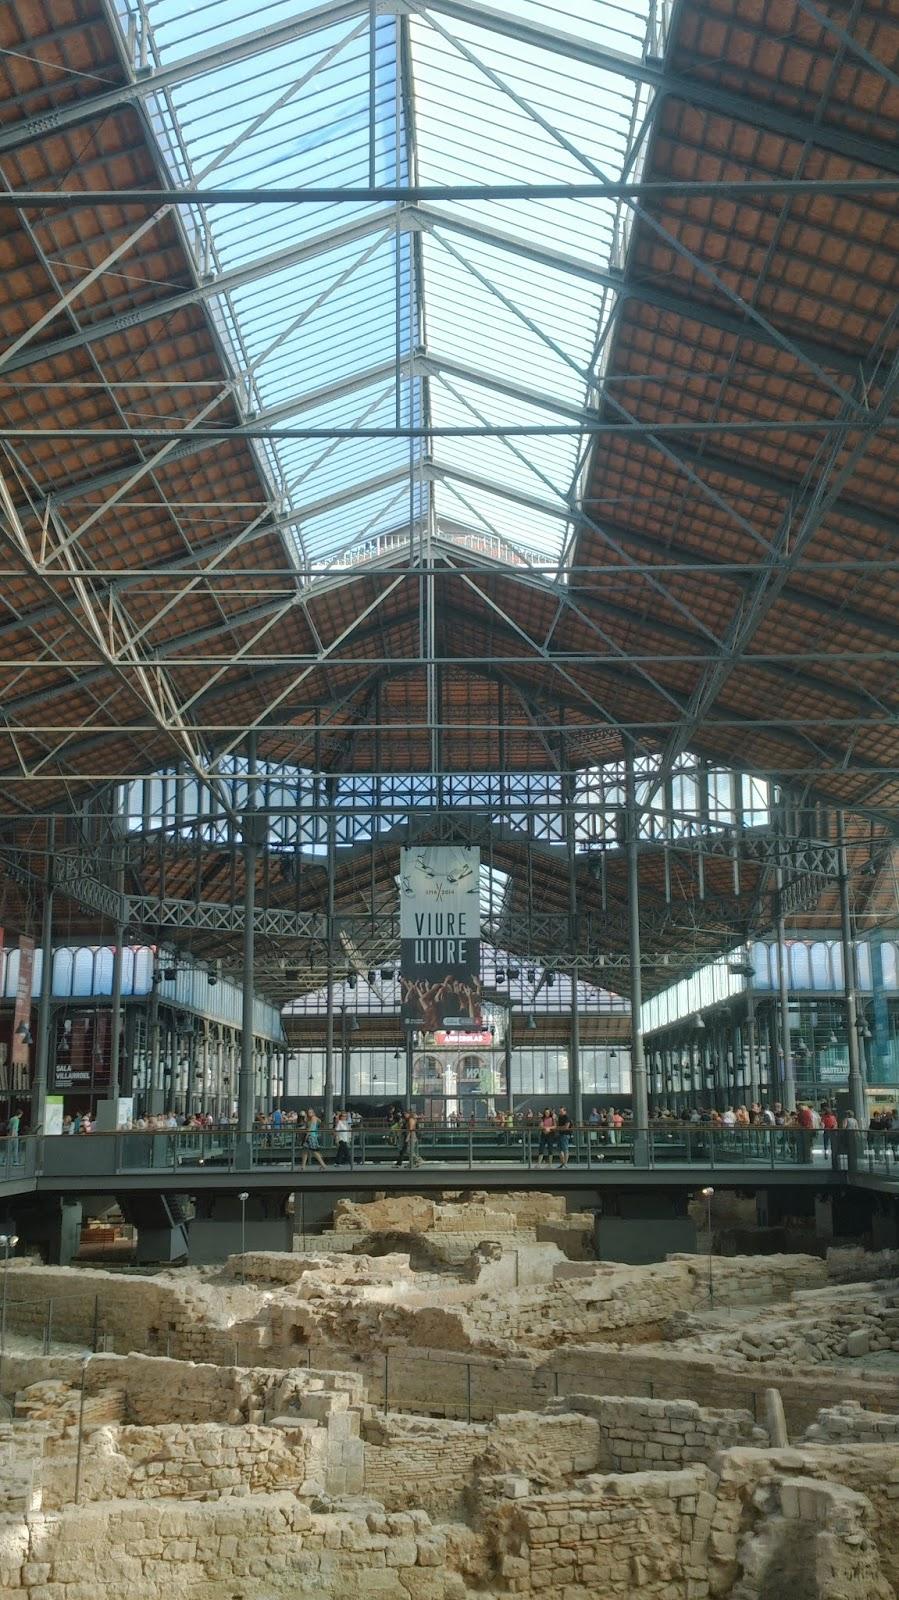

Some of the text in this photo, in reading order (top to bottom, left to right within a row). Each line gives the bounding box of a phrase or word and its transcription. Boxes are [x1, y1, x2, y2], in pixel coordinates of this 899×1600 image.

[415, 912, 467, 936] VIURE
[415, 939, 467, 964] LLIURE
[56, 1064, 72, 1072] SALA
